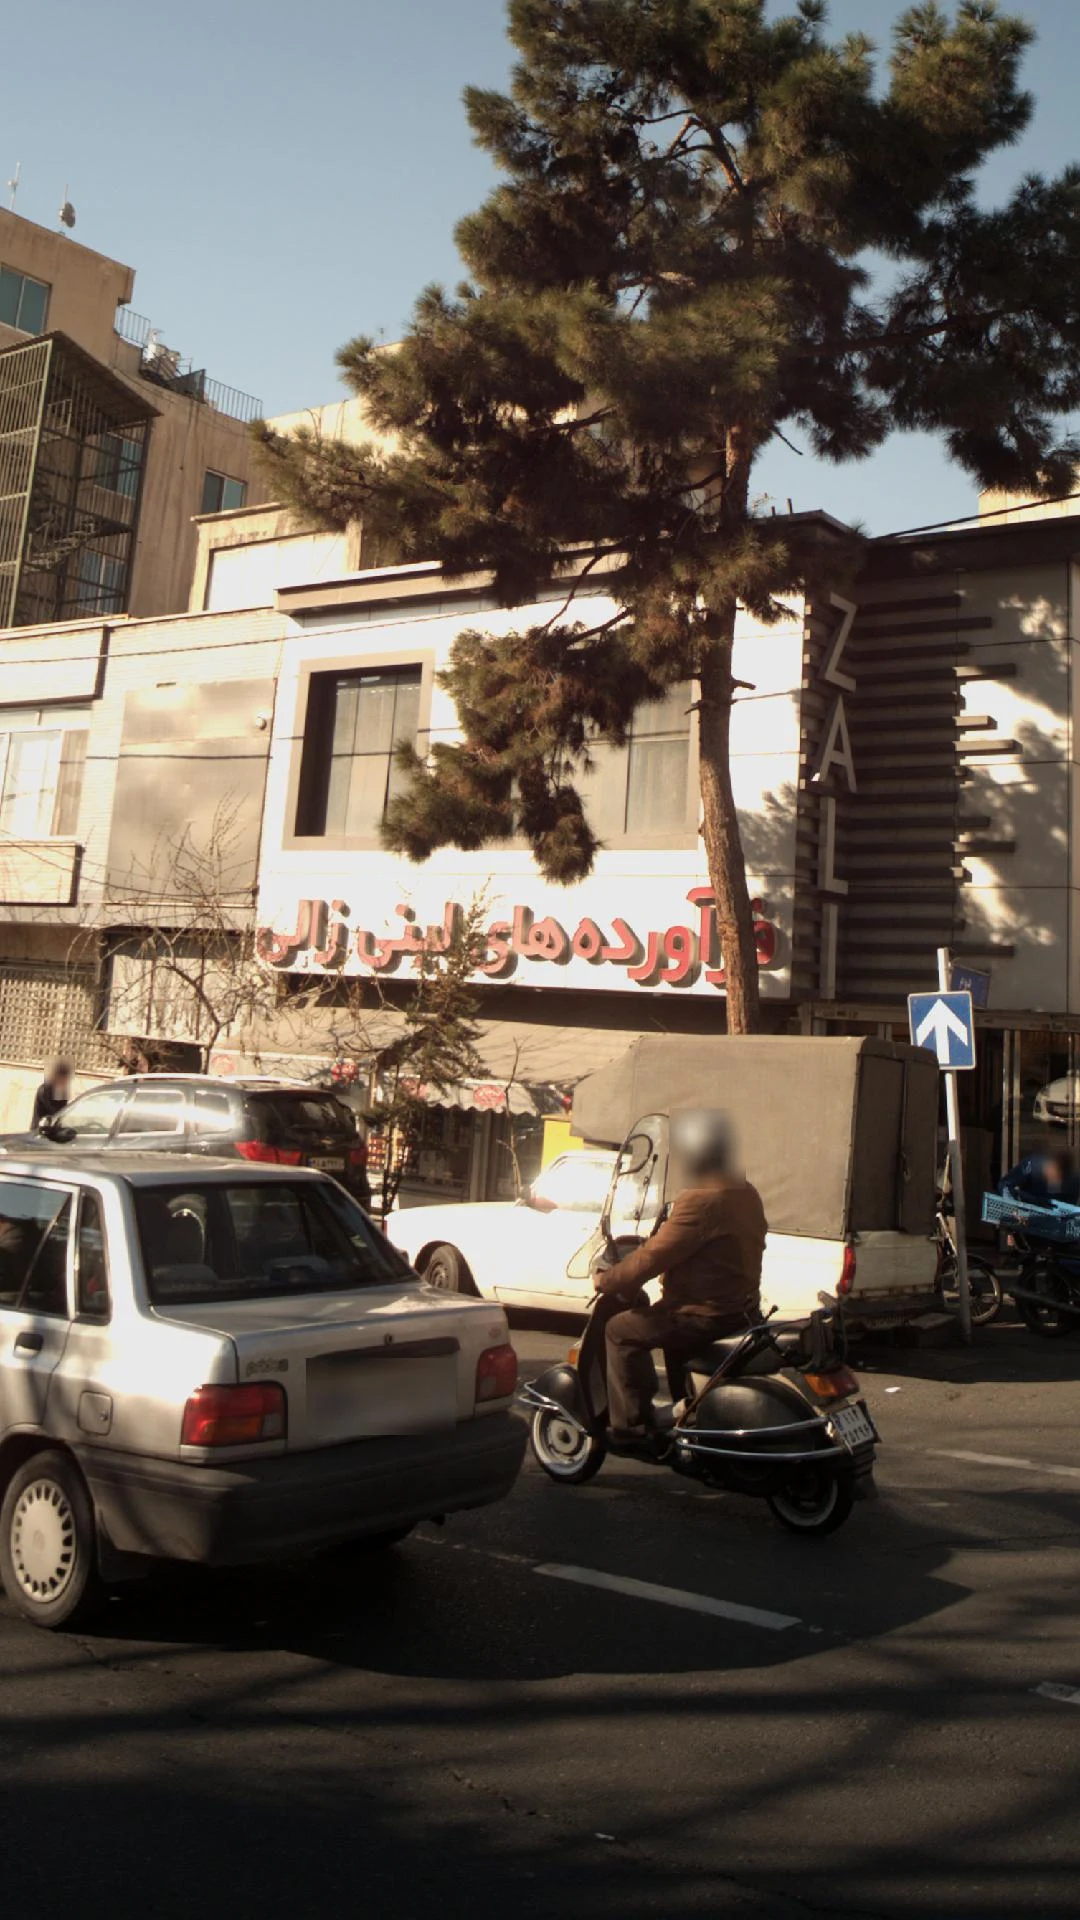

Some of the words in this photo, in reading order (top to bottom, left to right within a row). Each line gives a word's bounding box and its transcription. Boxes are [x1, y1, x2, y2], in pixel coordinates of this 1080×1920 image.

[818, 592, 858, 1000] ZALI
[257, 899, 348, 964] زالی
[358, 901, 463, 969] لبنی
